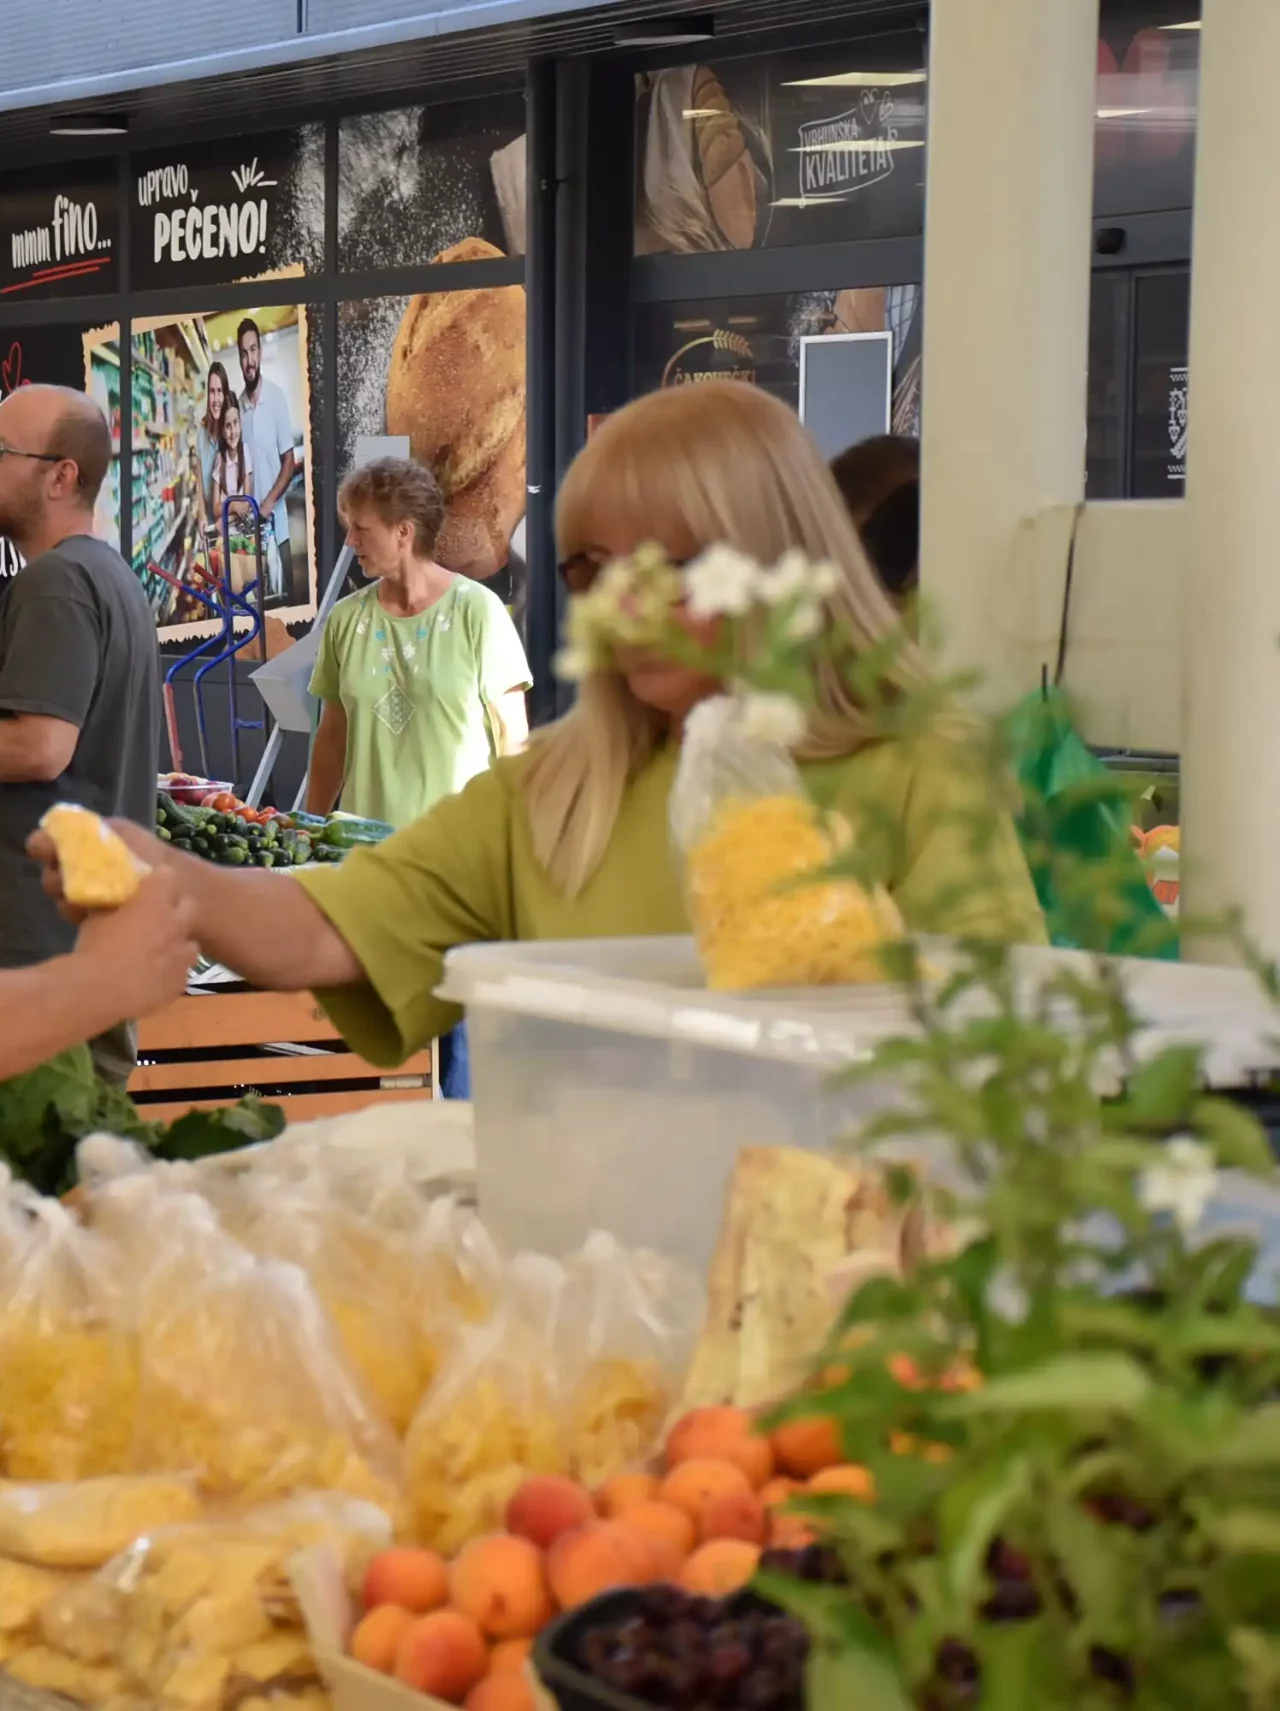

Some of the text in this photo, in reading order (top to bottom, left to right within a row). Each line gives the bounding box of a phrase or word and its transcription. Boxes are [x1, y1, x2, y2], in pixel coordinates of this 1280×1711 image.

[805, 136, 887, 190] KVALITETA
[12, 194, 111, 268] mmm fino...
[154, 189, 268, 263] PEČENO!
